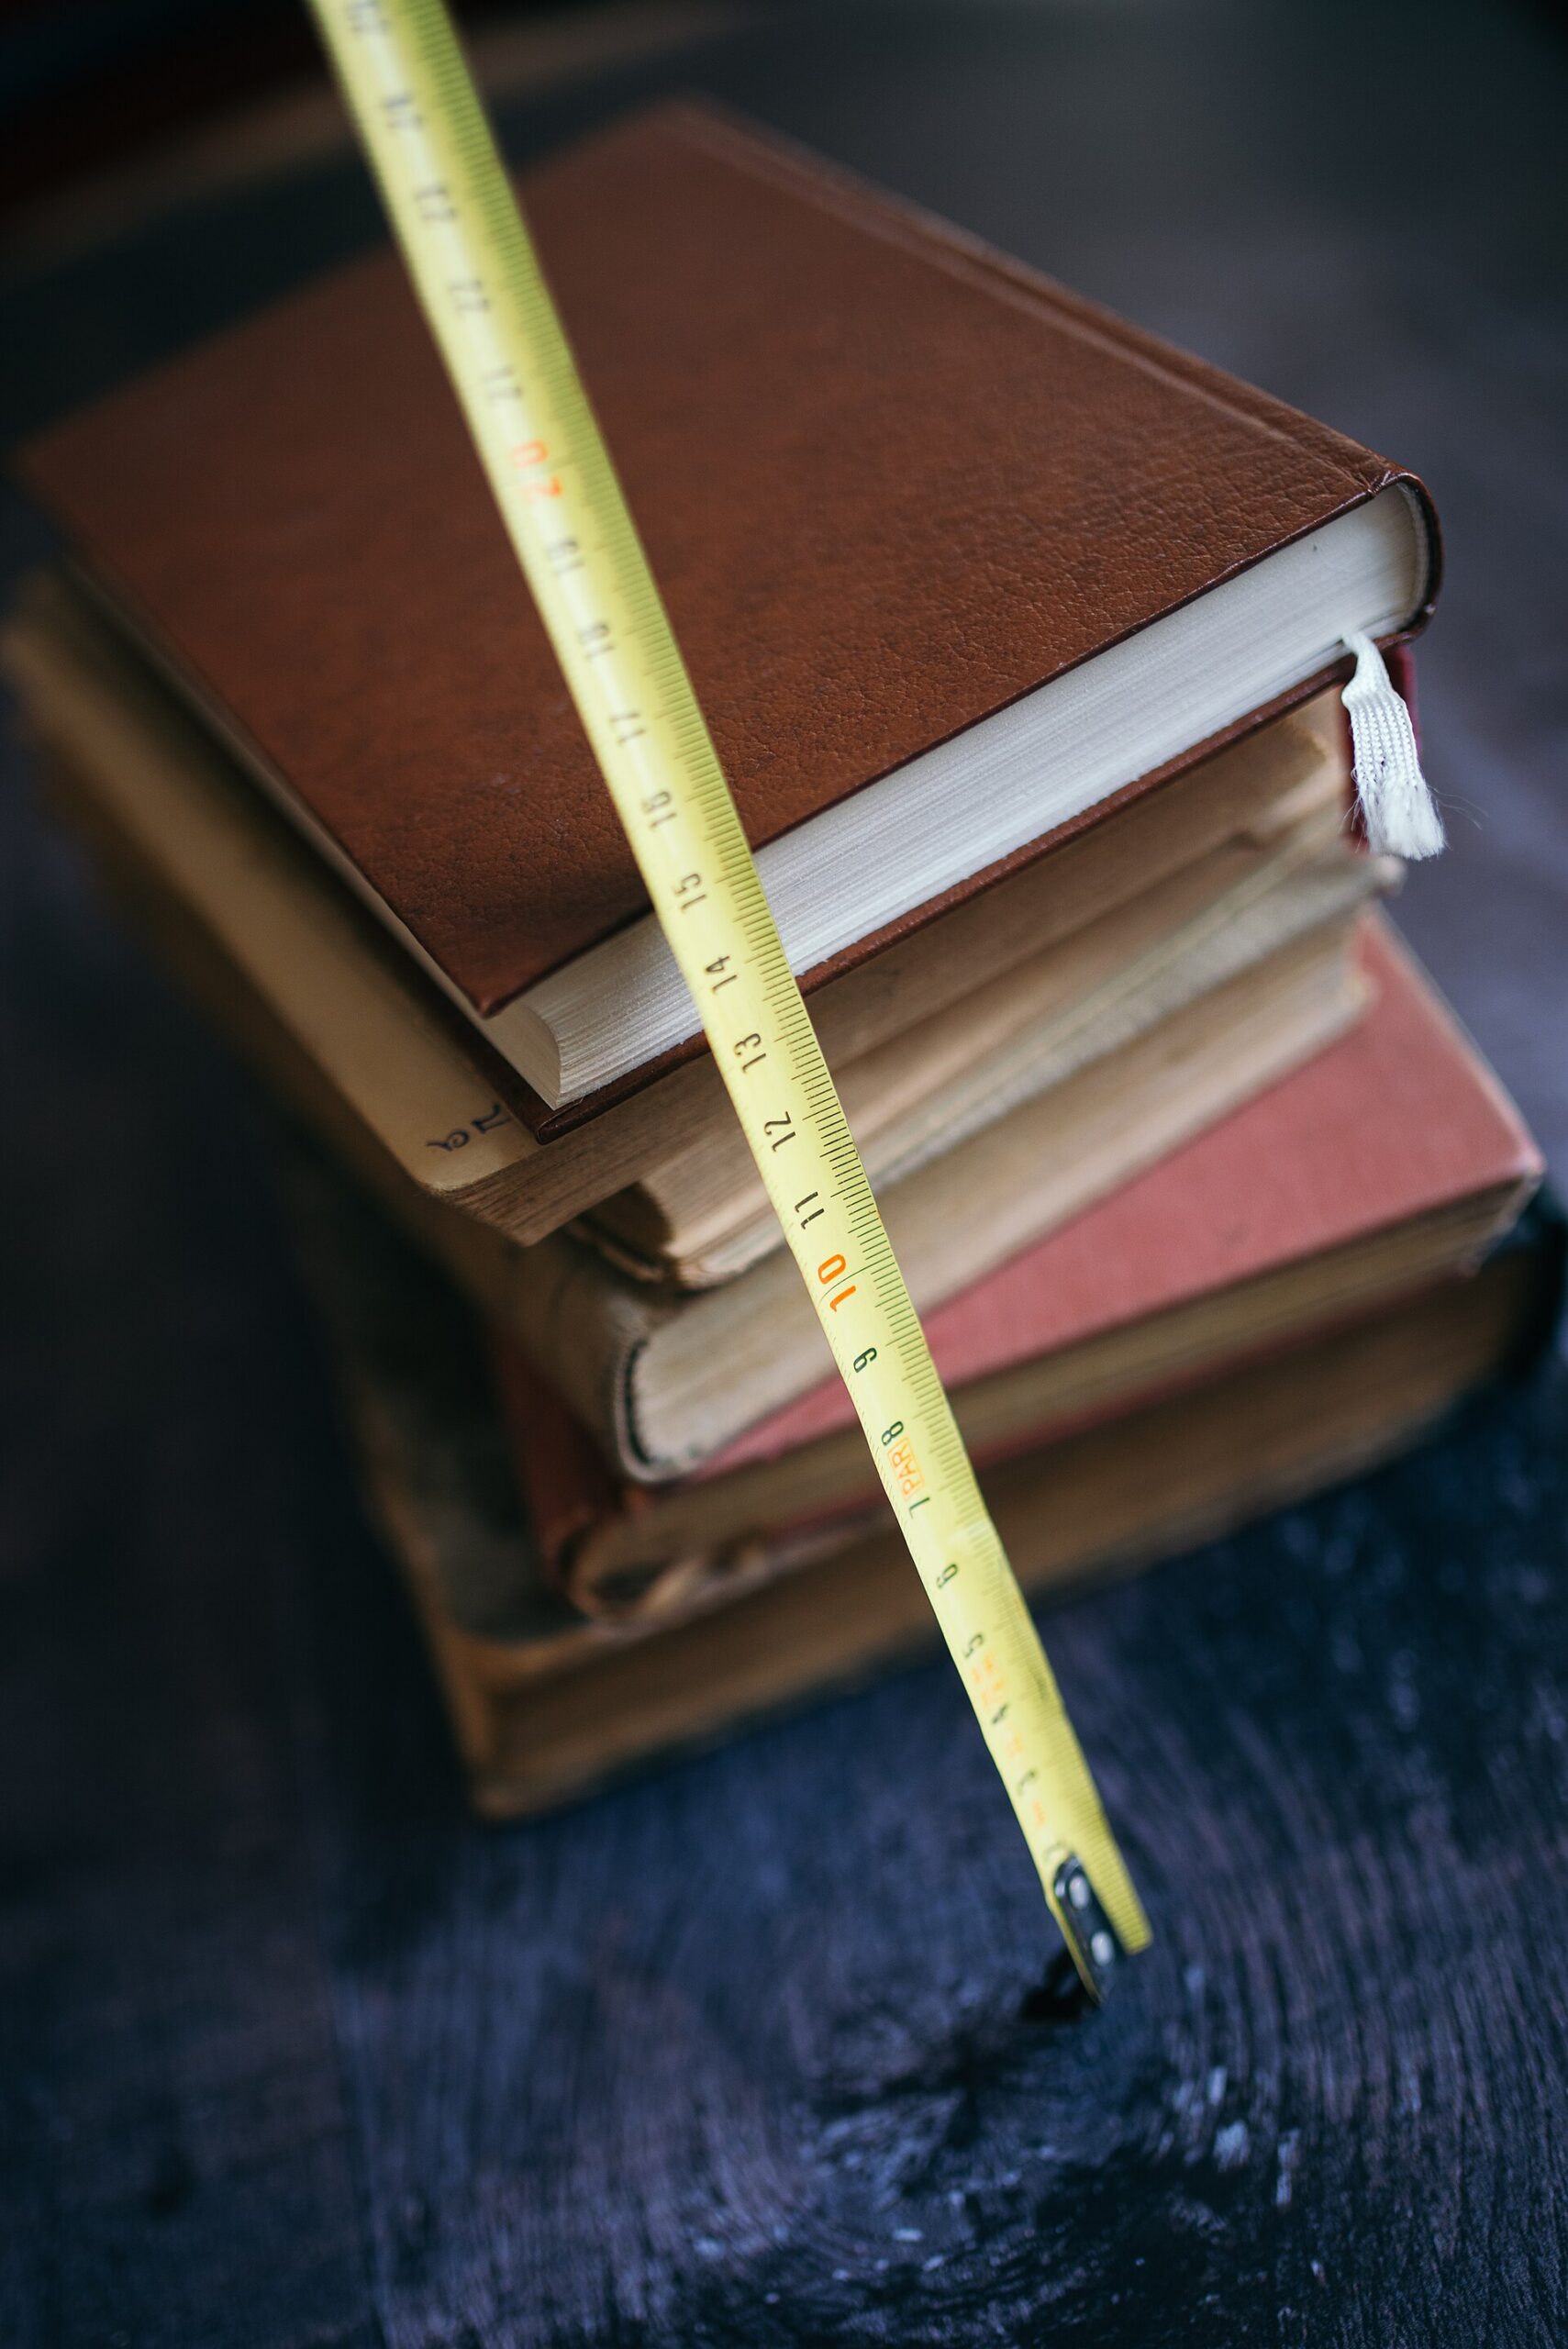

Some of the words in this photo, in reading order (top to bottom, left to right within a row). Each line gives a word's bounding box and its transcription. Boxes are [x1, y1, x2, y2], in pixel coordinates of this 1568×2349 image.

[513, 440, 562, 502] 20
[609, 712, 647, 748] 17
[639, 790, 677, 831] 16
[674, 873, 706, 912] 15
[705, 955, 737, 996] 14
[734, 1033, 766, 1074] 13
[764, 1111, 796, 1152] 12
[795, 1191, 825, 1230] 11
[817, 1253, 857, 1312] 10
[853, 1347, 877, 1374] 9
[881, 1420, 904, 1447] 8
[893, 1445, 921, 1497] PAR
[908, 1496, 930, 1520] 7
[936, 1564, 959, 1590] 6
[962, 1632, 984, 1658] 5
